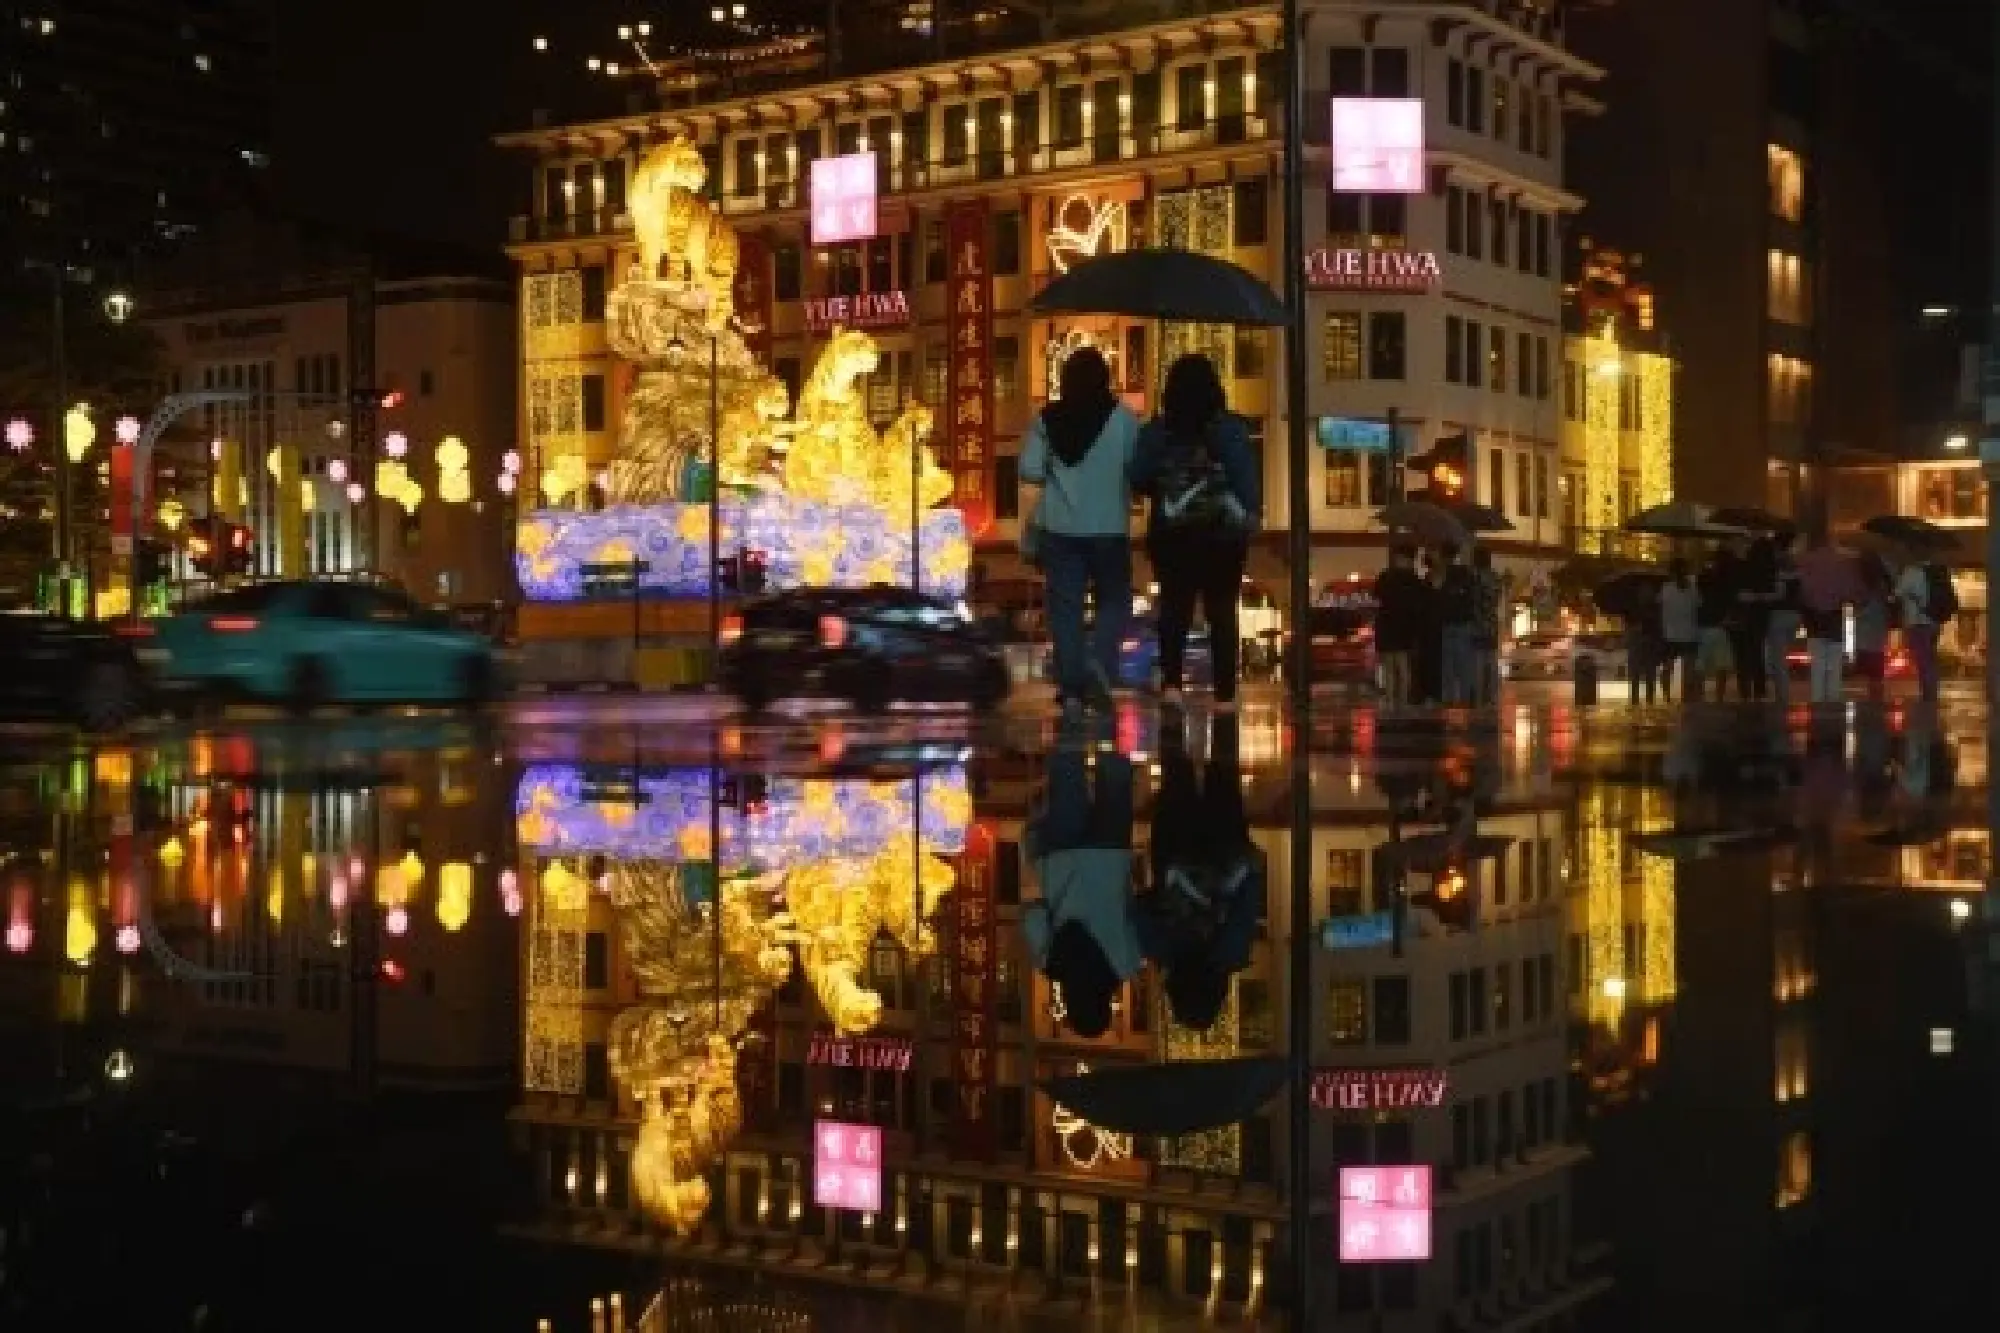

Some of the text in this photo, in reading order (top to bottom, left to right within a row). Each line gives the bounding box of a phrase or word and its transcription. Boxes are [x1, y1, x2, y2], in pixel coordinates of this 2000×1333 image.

[1305, 249, 1440, 275] YUE HWA
[804, 291, 910, 320] YUE HWA
